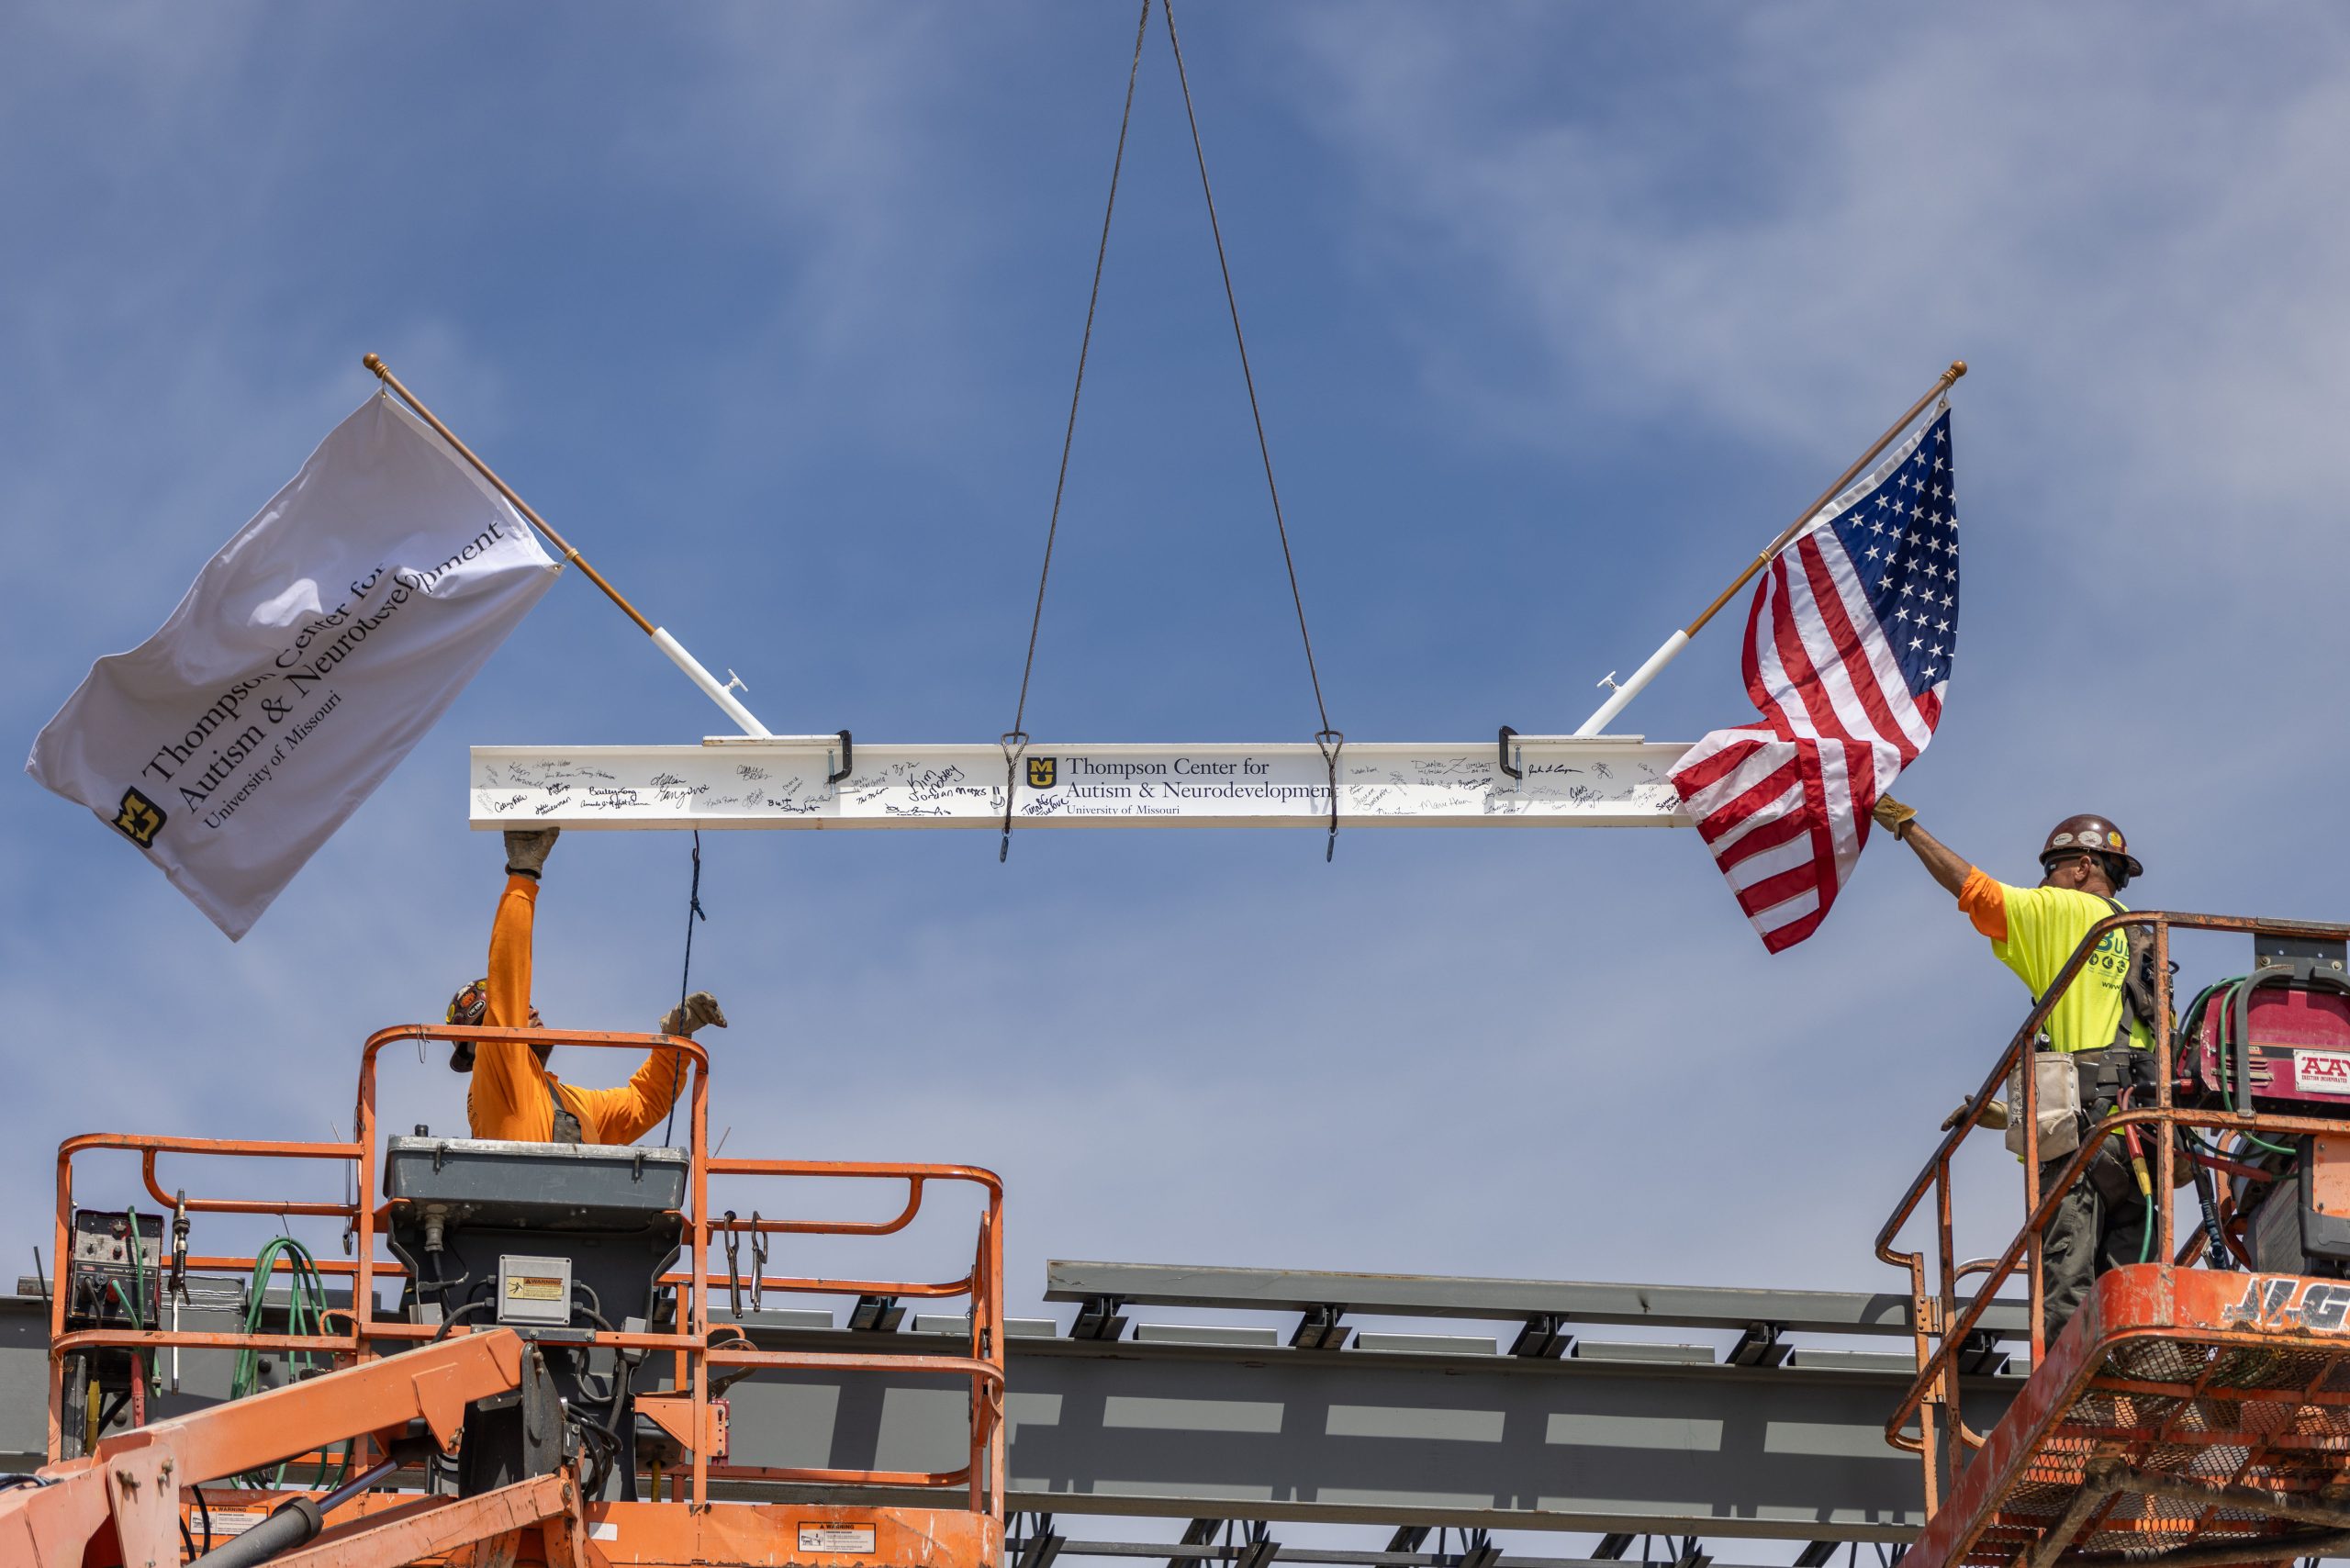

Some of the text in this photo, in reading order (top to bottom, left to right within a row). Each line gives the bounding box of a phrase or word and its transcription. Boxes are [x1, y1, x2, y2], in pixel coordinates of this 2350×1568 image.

[141, 562, 386, 783] Thompson Center for
[178, 724, 267, 815] Autism
[261, 695, 294, 724] &
[203, 689, 342, 830] University of Missouri
[1066, 756, 1270, 779] Thompson Center for
[1067, 781, 1131, 798] Autism
[1139, 781, 1154, 798] &
[1067, 804, 1180, 815] University of Missouri
